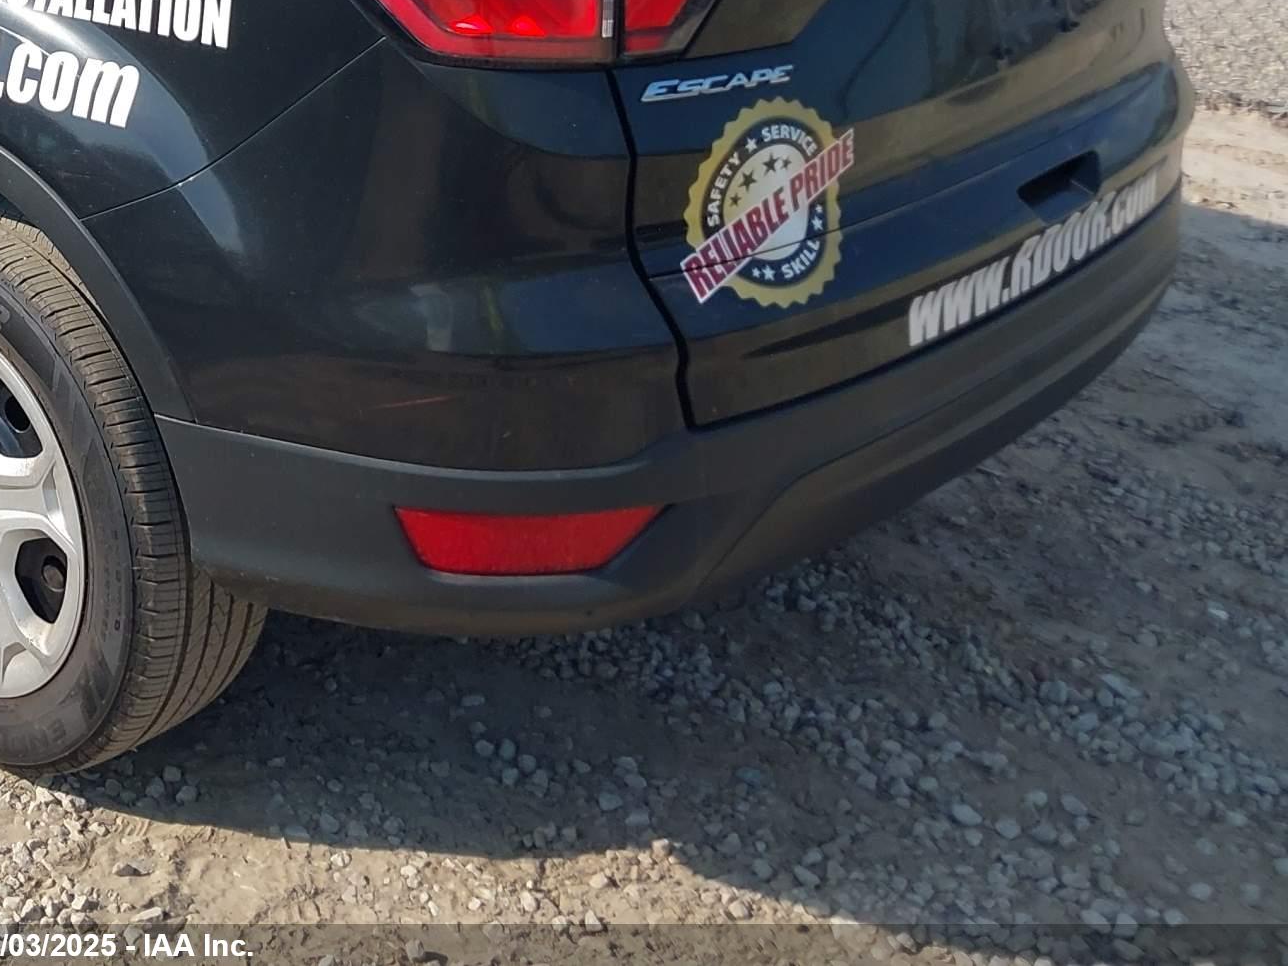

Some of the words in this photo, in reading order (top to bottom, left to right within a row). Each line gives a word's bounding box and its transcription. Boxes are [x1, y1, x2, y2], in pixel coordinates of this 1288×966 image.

[640, 64, 795, 102] ESCAPE
[706, 150, 741, 228] SAFETY
[761, 123, 818, 157] SERVICE
[684, 186, 790, 299] RELIABLE
[789, 136, 854, 212] PRIDE
[781, 240, 821, 280] SKILL
